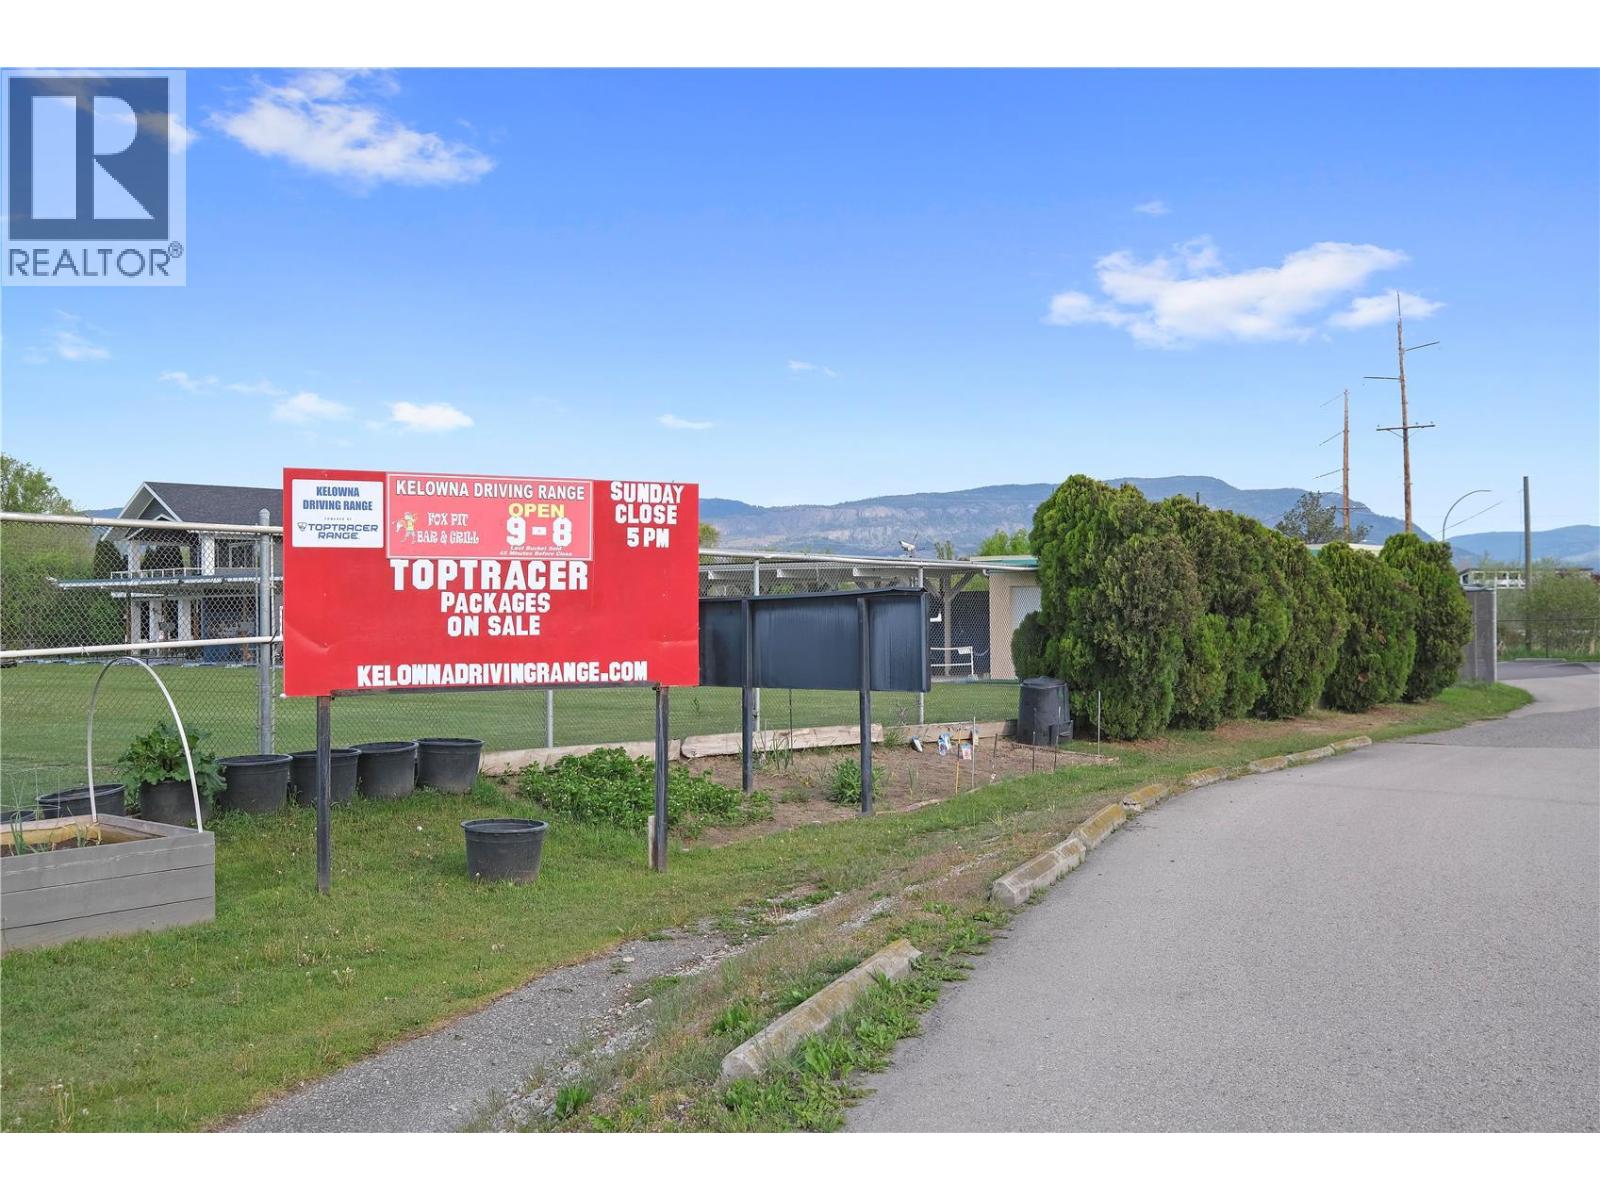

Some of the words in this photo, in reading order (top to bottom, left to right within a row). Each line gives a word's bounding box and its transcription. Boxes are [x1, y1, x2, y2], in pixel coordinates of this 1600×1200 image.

[316, 486, 360, 497] KELOWNA
[396, 479, 470, 497] KELOWNA
[473, 482, 533, 499] DRIVING
[538, 484, 585, 501] RANGE
[610, 481, 684, 504] SUNDAY
[303, 499, 342, 511] DRIVING
[343, 500, 373, 511] RANGE
[508, 503, 565, 518] OPEN
[615, 503, 678, 525] CLOSE
[308, 523, 379, 532] TOPTRACER
[427, 511, 448, 526] FOX
[450, 513, 469, 527] PIT
[318, 532, 360, 540] RANGE
[417, 530, 438, 543] BAR
[440, 530, 448, 544] &
[449, 530, 480, 544] GRILL
[627, 527, 640, 548] 5
[643, 527, 670, 548] PM
[390, 559, 589, 591] TOPTRACER
[440, 592, 551, 614] PACKAGES
[447, 615, 480, 637] ON
[487, 615, 540, 637] SALE
[357, 660, 648, 687] KELOWNADRIVINGRANGE.COM
